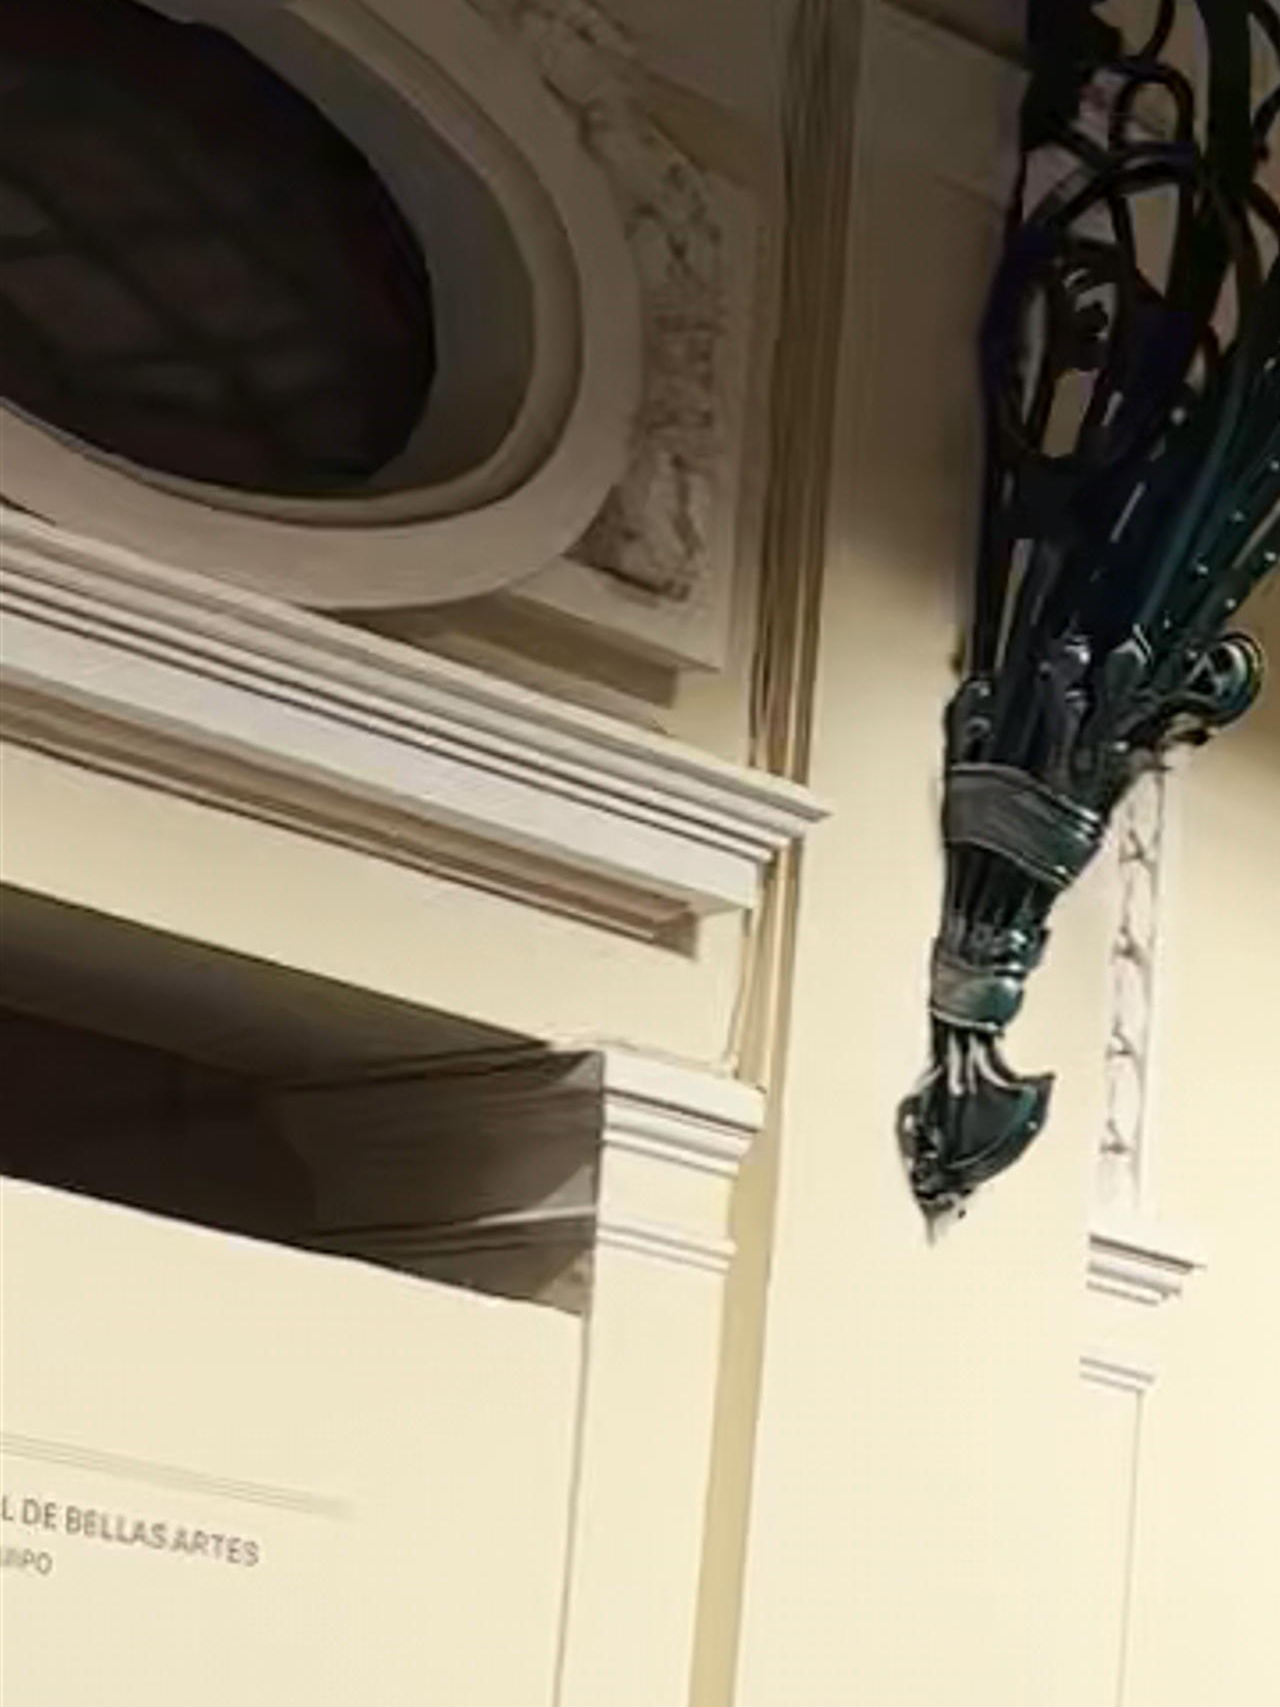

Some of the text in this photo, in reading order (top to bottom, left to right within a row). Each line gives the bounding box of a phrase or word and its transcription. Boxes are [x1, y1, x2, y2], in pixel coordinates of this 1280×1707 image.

[22, 1498, 57, 1530] DE
[65, 1505, 167, 1549] BELLAS
[170, 1526, 260, 1567] ARTES
